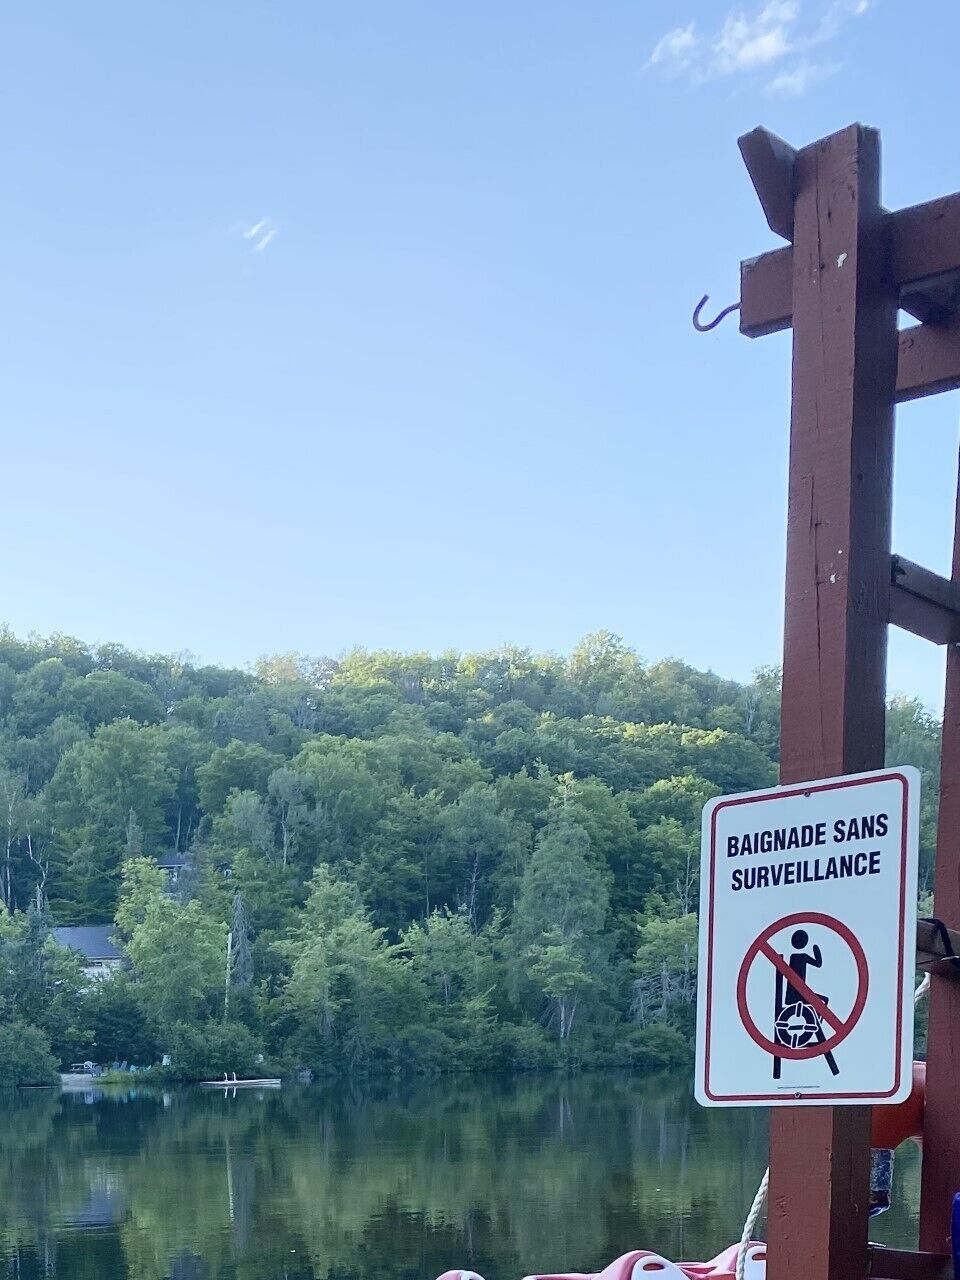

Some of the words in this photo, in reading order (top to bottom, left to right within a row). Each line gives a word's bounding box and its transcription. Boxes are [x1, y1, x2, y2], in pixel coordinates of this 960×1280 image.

[727, 822, 826, 857] BAIGNADE
[833, 813, 889, 843] SANS
[731, 851, 881, 891] SURVEILLANCE
